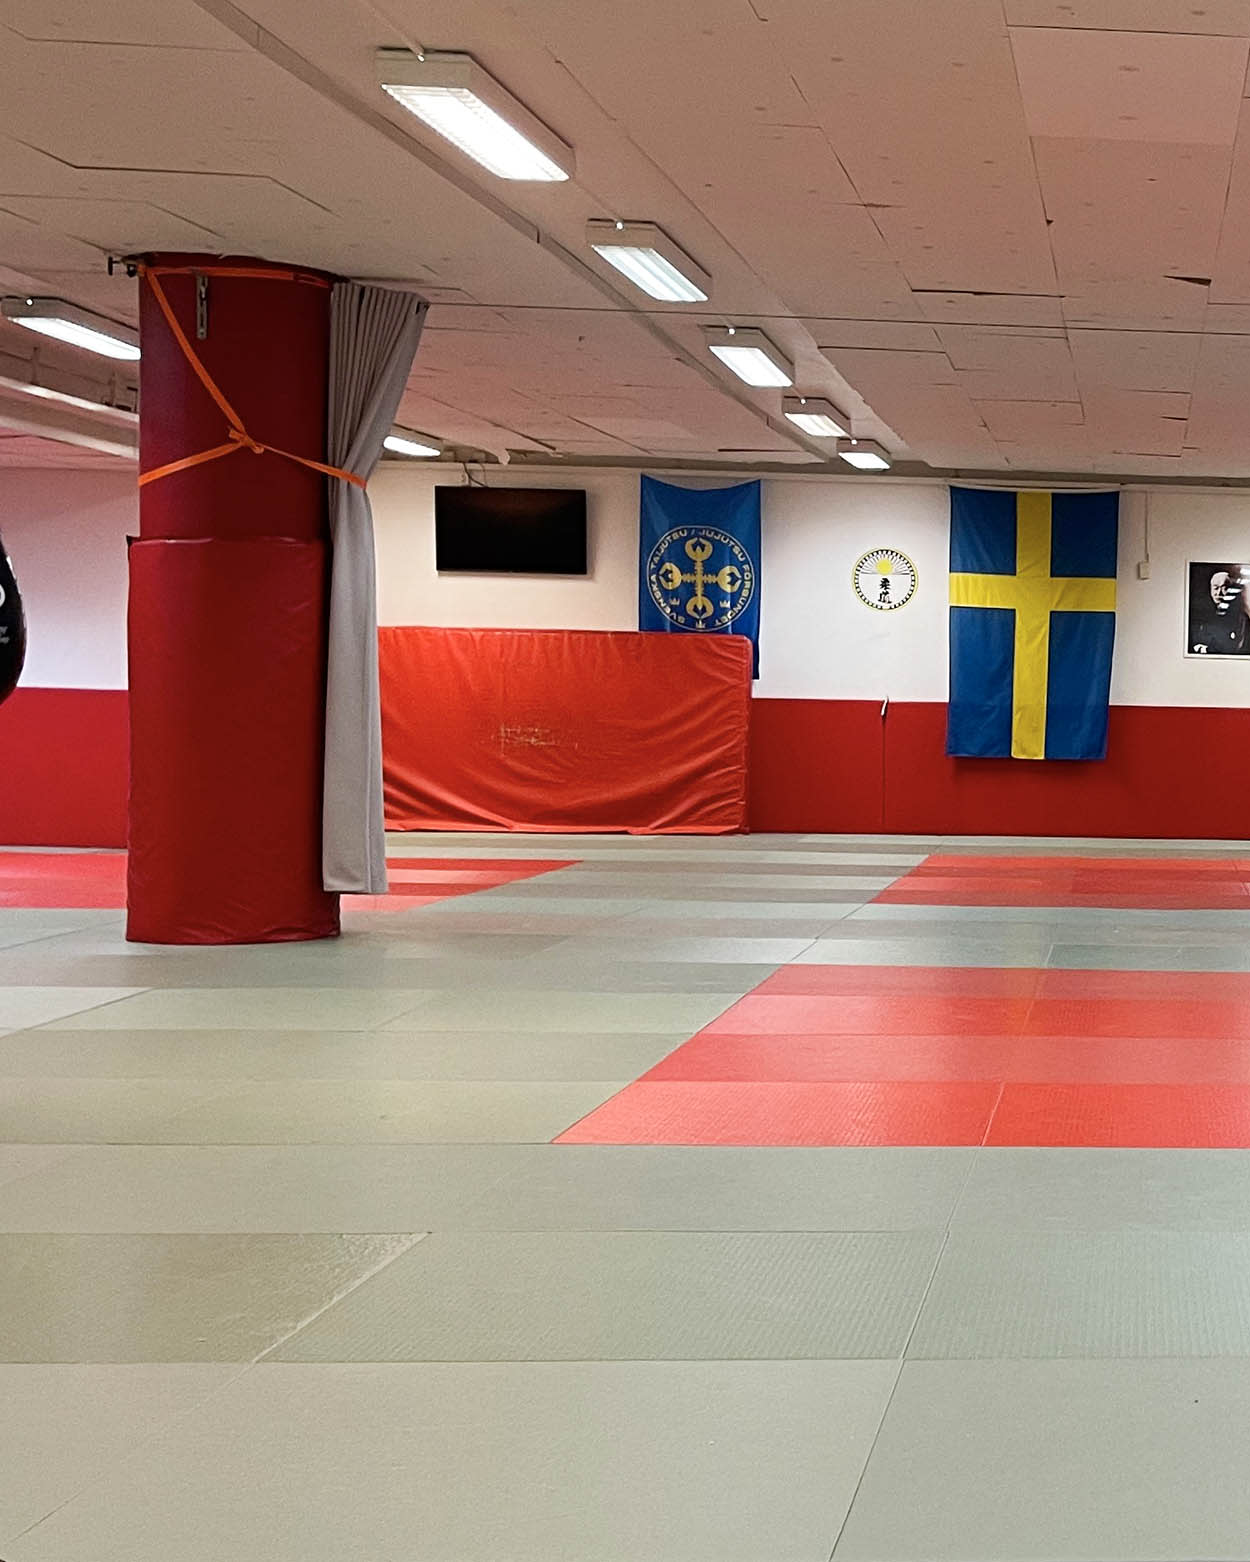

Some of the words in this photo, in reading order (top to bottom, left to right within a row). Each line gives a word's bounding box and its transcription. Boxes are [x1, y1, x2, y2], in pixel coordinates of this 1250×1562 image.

[650, 529, 687, 570] TAIJUTSU
[698, 529, 746, 562] JUJUTSU
[650, 574, 685, 624] SVENSKA
